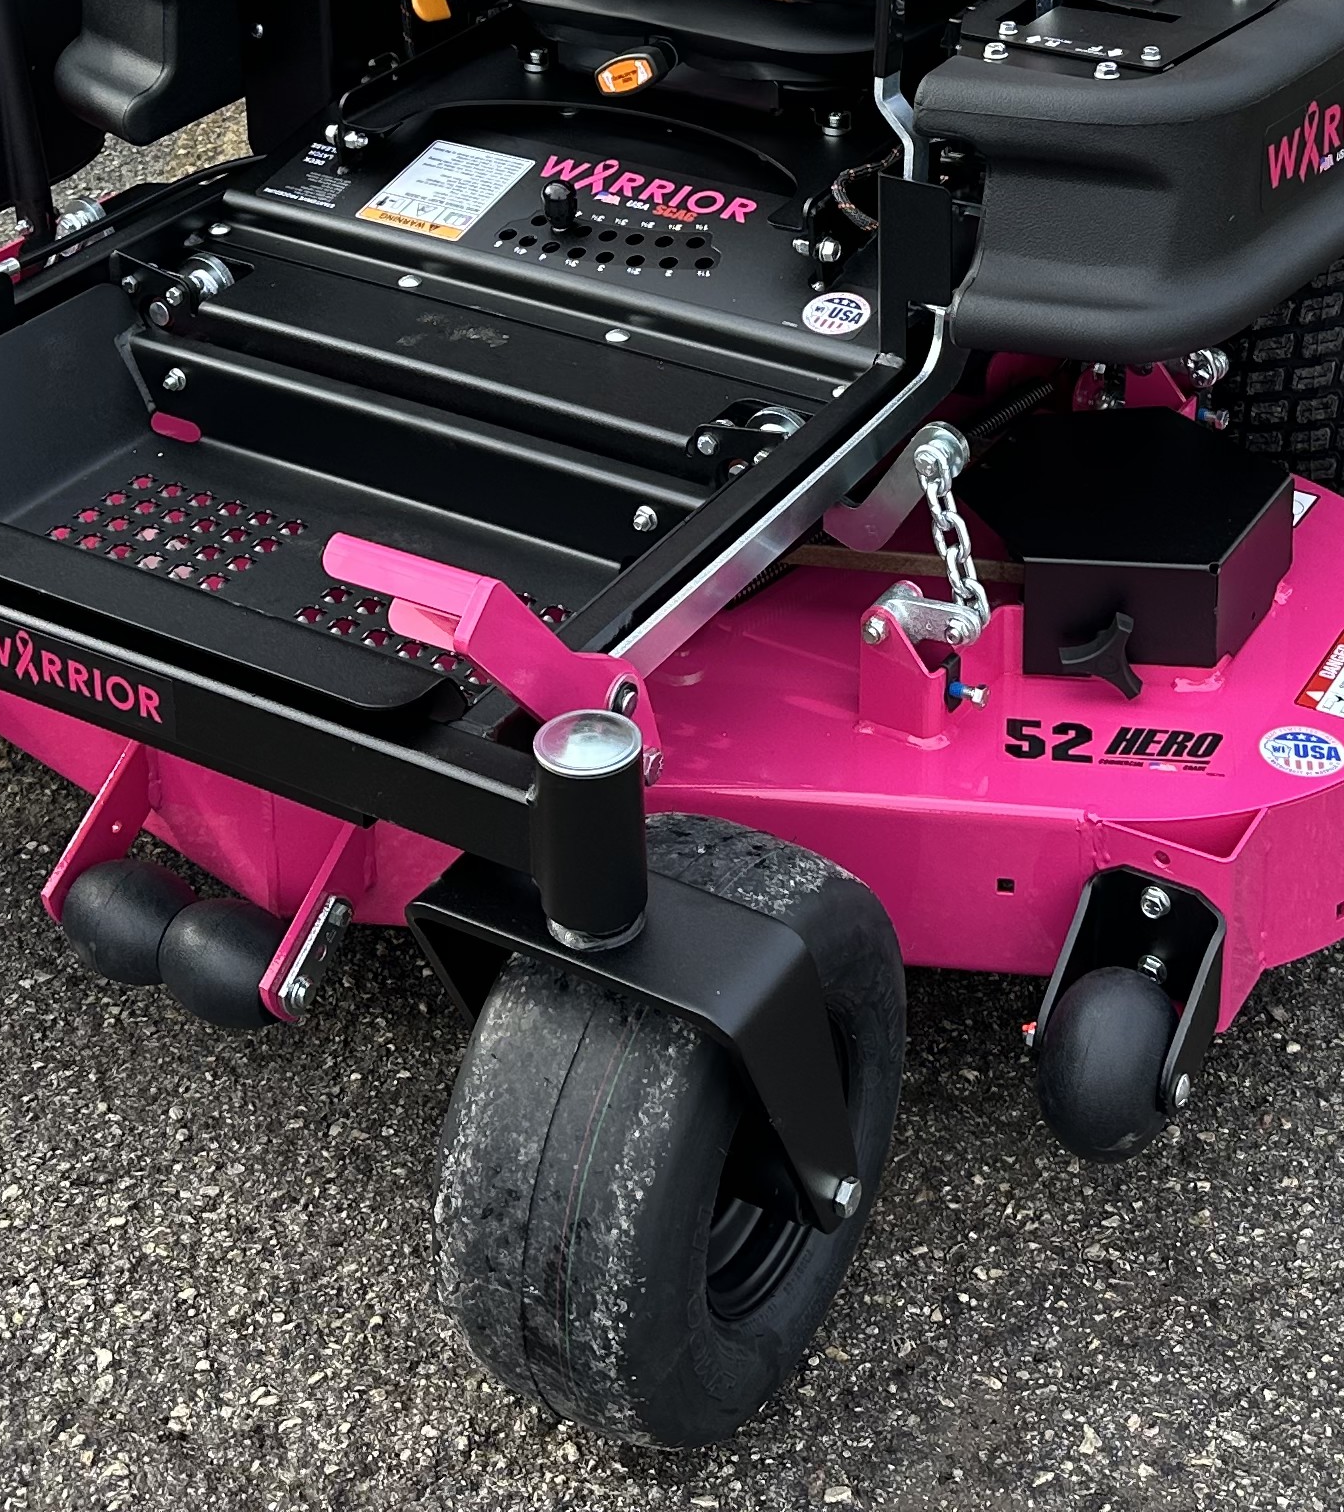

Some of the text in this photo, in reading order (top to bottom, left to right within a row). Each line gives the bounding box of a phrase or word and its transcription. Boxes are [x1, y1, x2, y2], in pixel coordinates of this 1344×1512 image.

[540, 154, 758, 224] WARRIOR
[378, 212, 427, 230] WARNING
[625, 199, 699, 223] USA SCAG
[828, 306, 864, 325] USA
[1005, 717, 1094, 764] 52
[1103, 726, 1224, 759] HERO
[1271, 743, 1342, 762] WI USA
